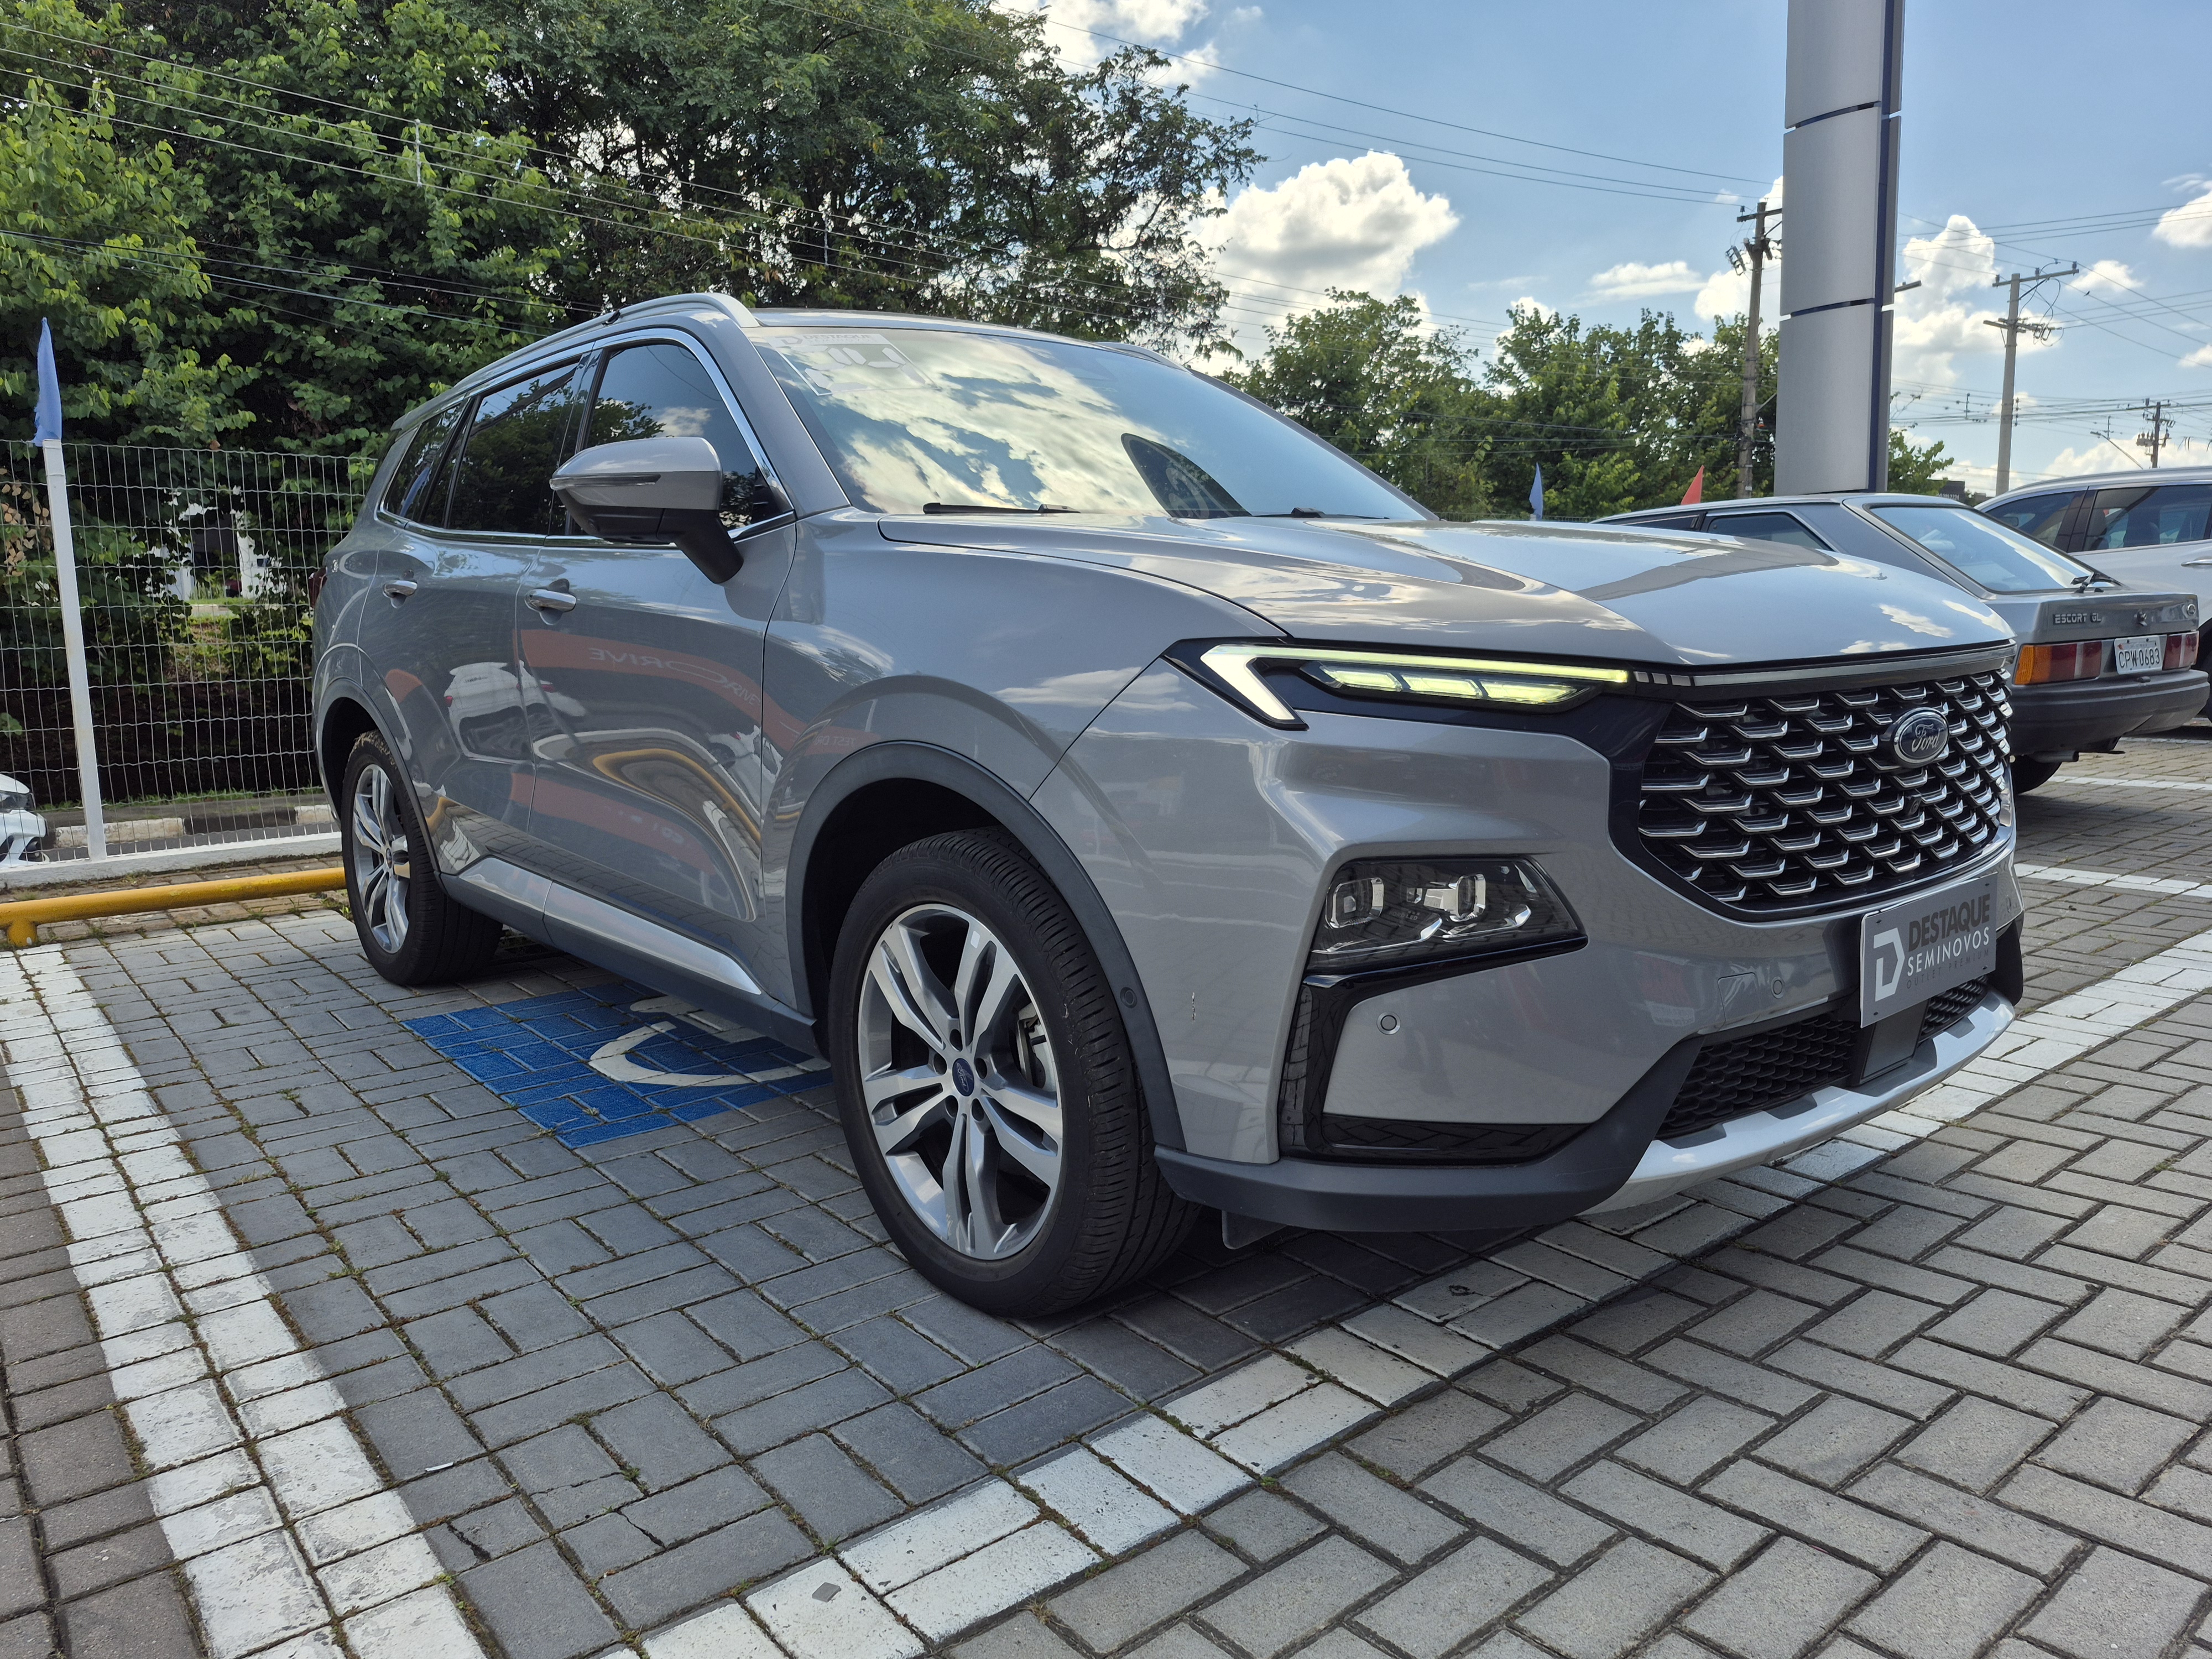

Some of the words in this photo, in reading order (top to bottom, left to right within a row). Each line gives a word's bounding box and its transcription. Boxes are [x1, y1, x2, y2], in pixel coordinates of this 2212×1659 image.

[2054, 613, 2088, 624] ESCORT
[2092, 612, 2101, 622] GL
[1911, 723, 1940, 752] Ford
[1908, 893, 1990, 952] DESTAQUE
[1907, 926, 1990, 977] SEMINOVOS
[1907, 967, 1941, 989] OUTLET
[1949, 948, 1989, 972] PREMIUM
